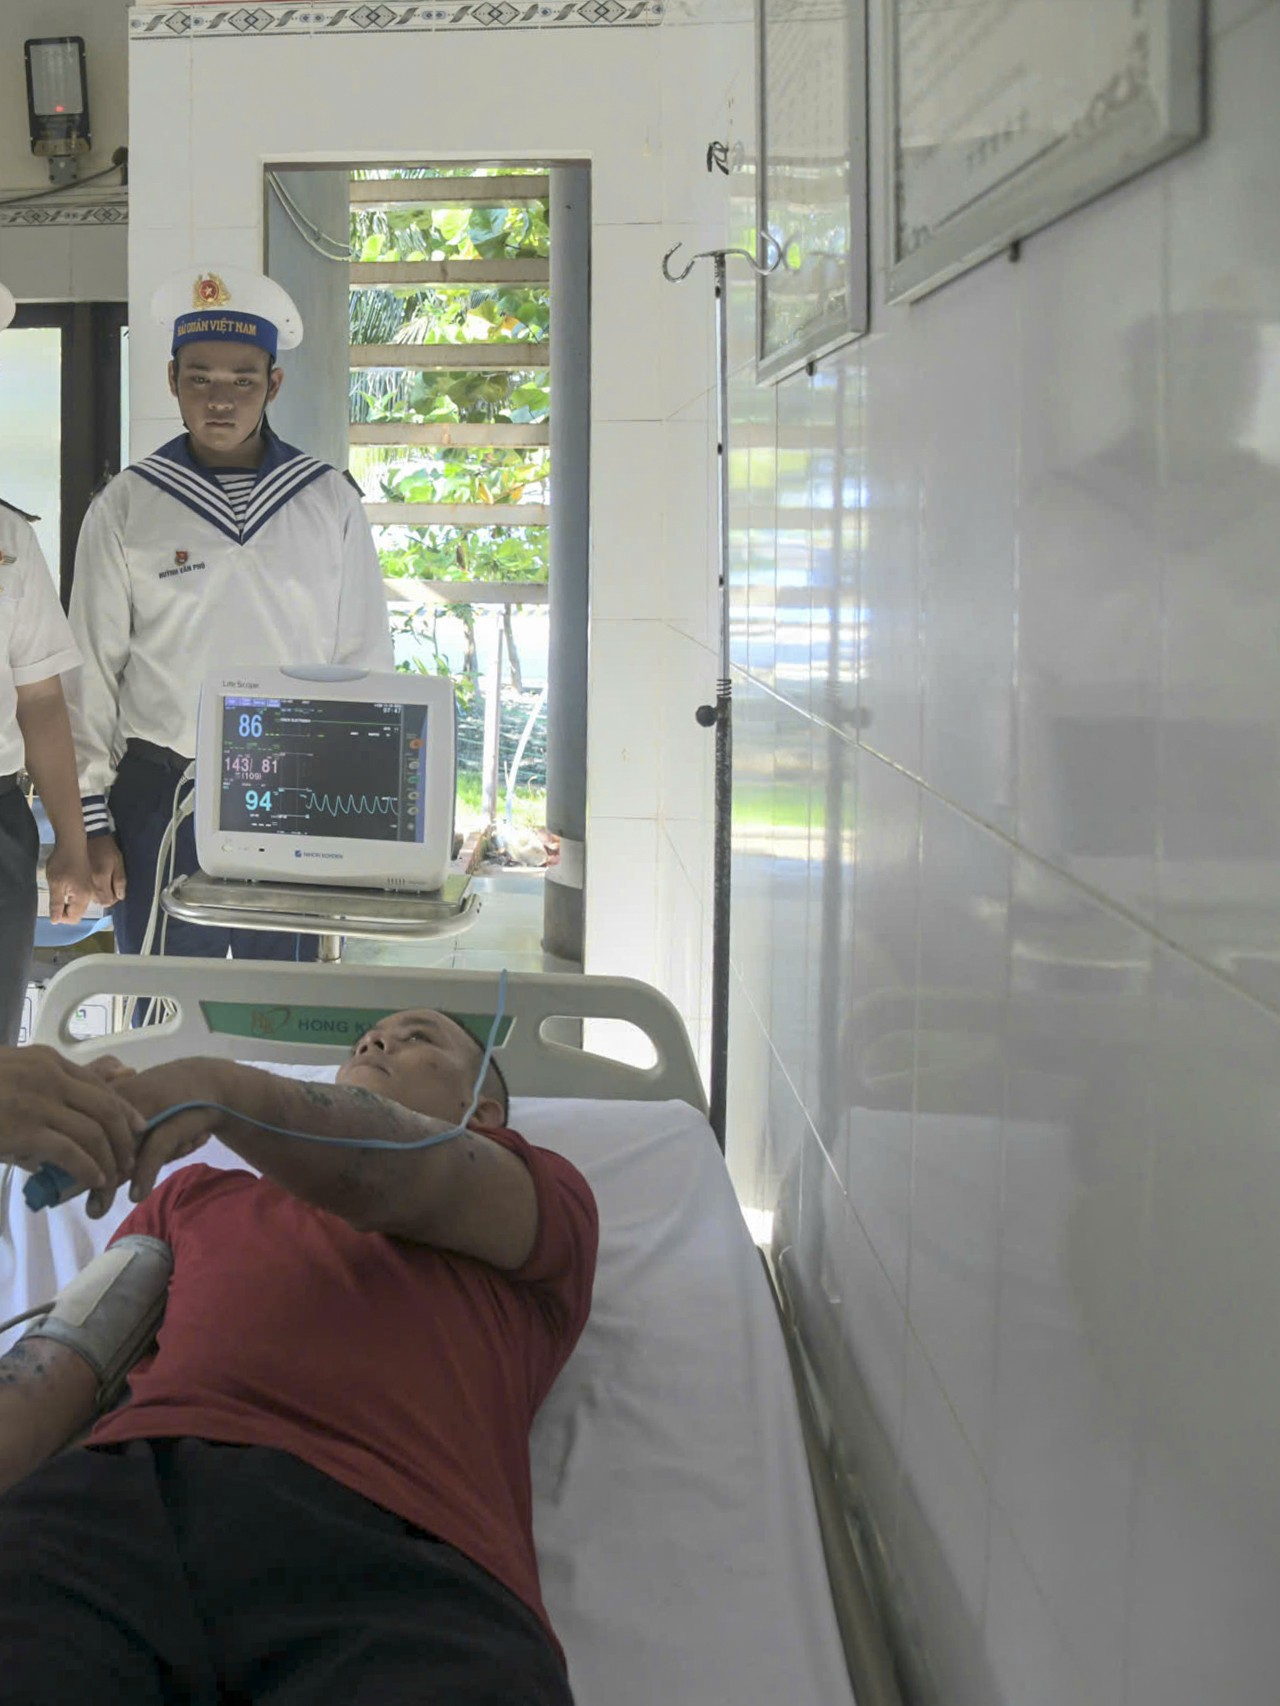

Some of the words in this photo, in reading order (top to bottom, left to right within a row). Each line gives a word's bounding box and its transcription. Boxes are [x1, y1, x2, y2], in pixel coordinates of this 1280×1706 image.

[210, 317, 234, 334] VIỆT
[236, 321, 257, 336] NAM
[238, 714, 263, 738] 86
[261, 759, 278, 774] 81
[245, 790, 272, 812] 94
